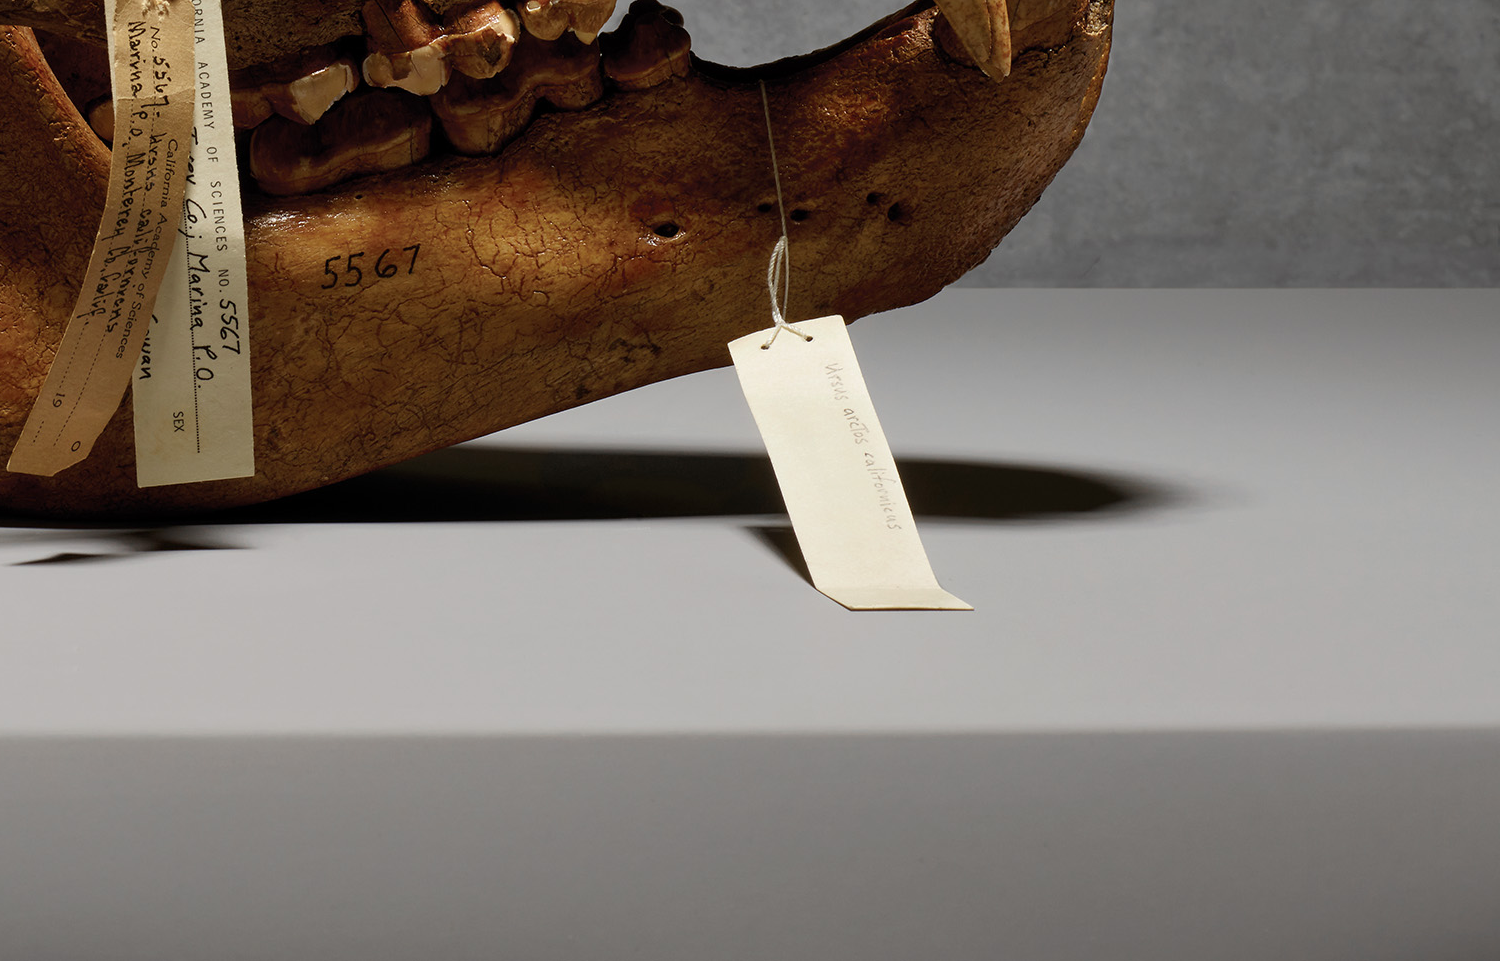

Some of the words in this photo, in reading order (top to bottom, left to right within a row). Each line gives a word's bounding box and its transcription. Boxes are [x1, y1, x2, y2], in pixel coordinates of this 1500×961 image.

[128, 21, 146, 98] Marina
[150, 26, 161, 52] No.
[198, 62, 214, 130] ACADEMY
[160, 138, 178, 208] California
[207, 147, 219, 163] OF
[101, 152, 146, 241] Monterey
[210, 181, 227, 251] SCIENCES
[142, 213, 167, 279] Academy
[321, 243, 421, 289] 5567
[136, 283, 145, 300] of
[188, 252, 211, 330] Marina
[219, 269, 230, 293] NO.
[116, 301, 141, 359] Sciences
[219, 299, 240, 355] 5567
[52, 392, 65, 408] 19
[173, 411, 185, 433] SEX
[825, 362, 849, 401] Ursus
[843, 408, 870, 445] arctos
[864, 452, 902, 530] californicus
